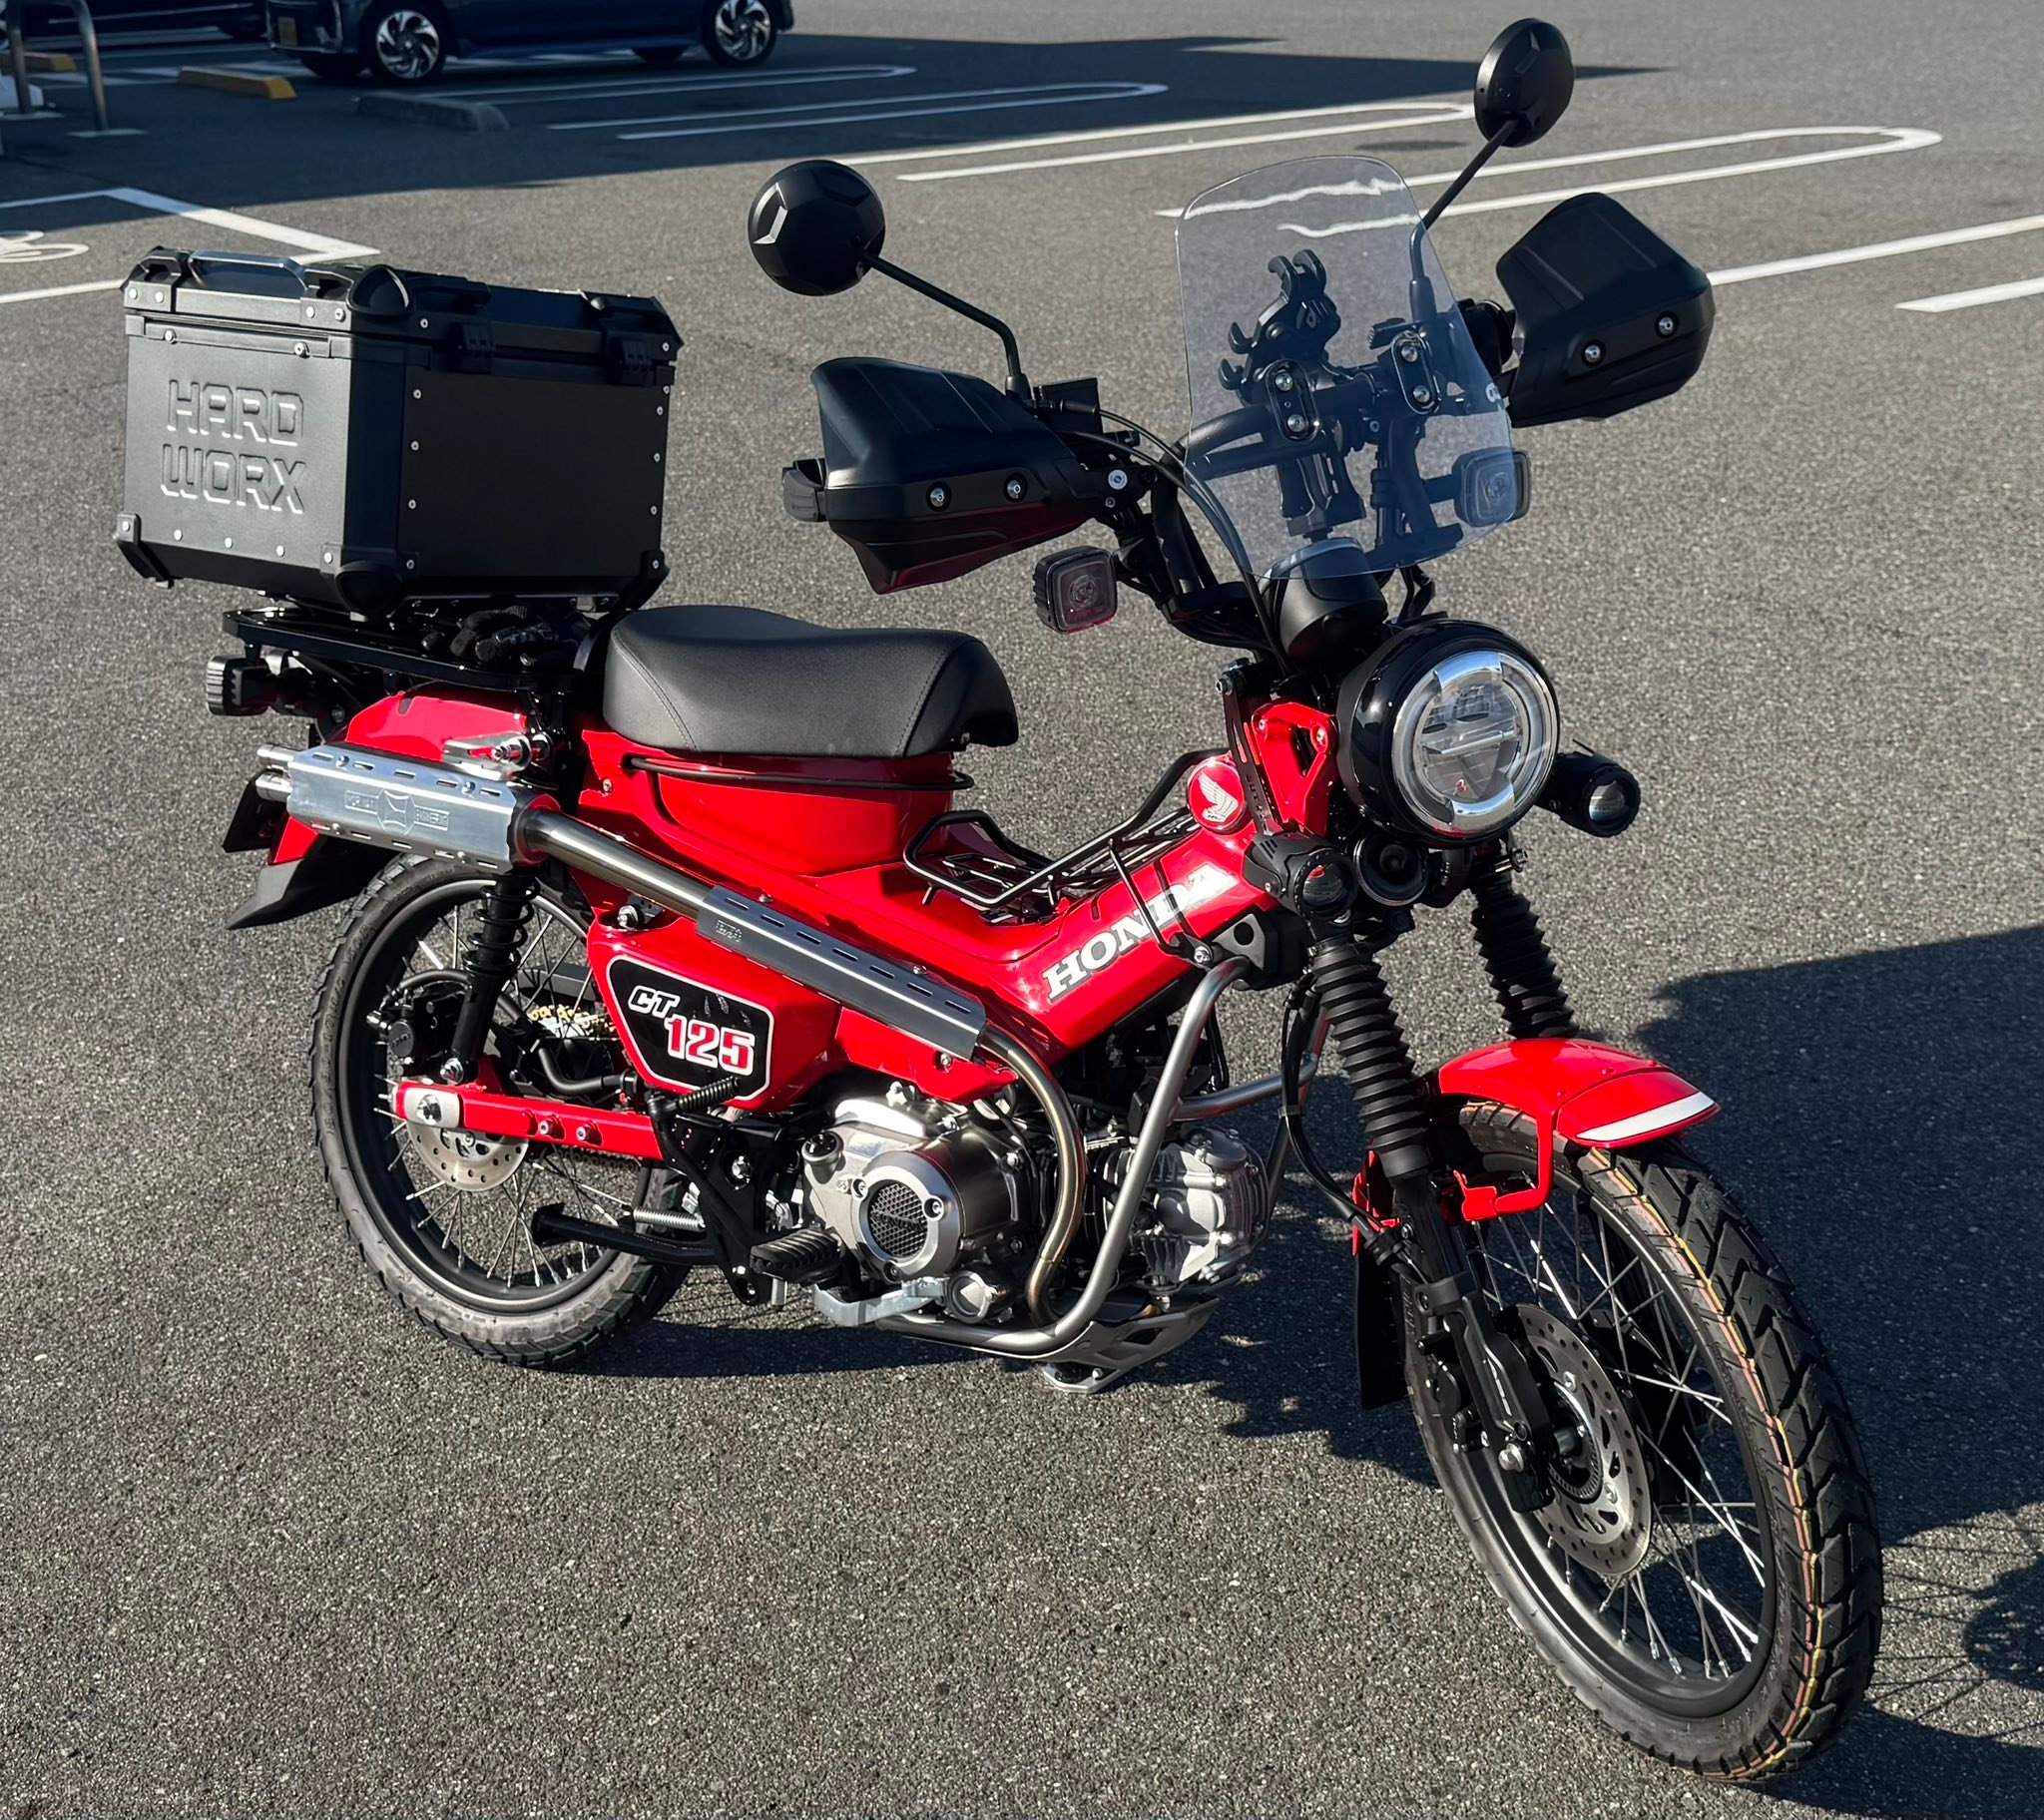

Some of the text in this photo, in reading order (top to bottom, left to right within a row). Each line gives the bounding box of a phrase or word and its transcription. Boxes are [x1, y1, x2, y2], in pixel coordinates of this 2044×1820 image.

[167, 379, 303, 446] HARD
[161, 443, 305, 514] WORX
[1042, 861, 1240, 1001] HONDA
[628, 985, 681, 1019] CT
[664, 1014, 756, 1076] 125
